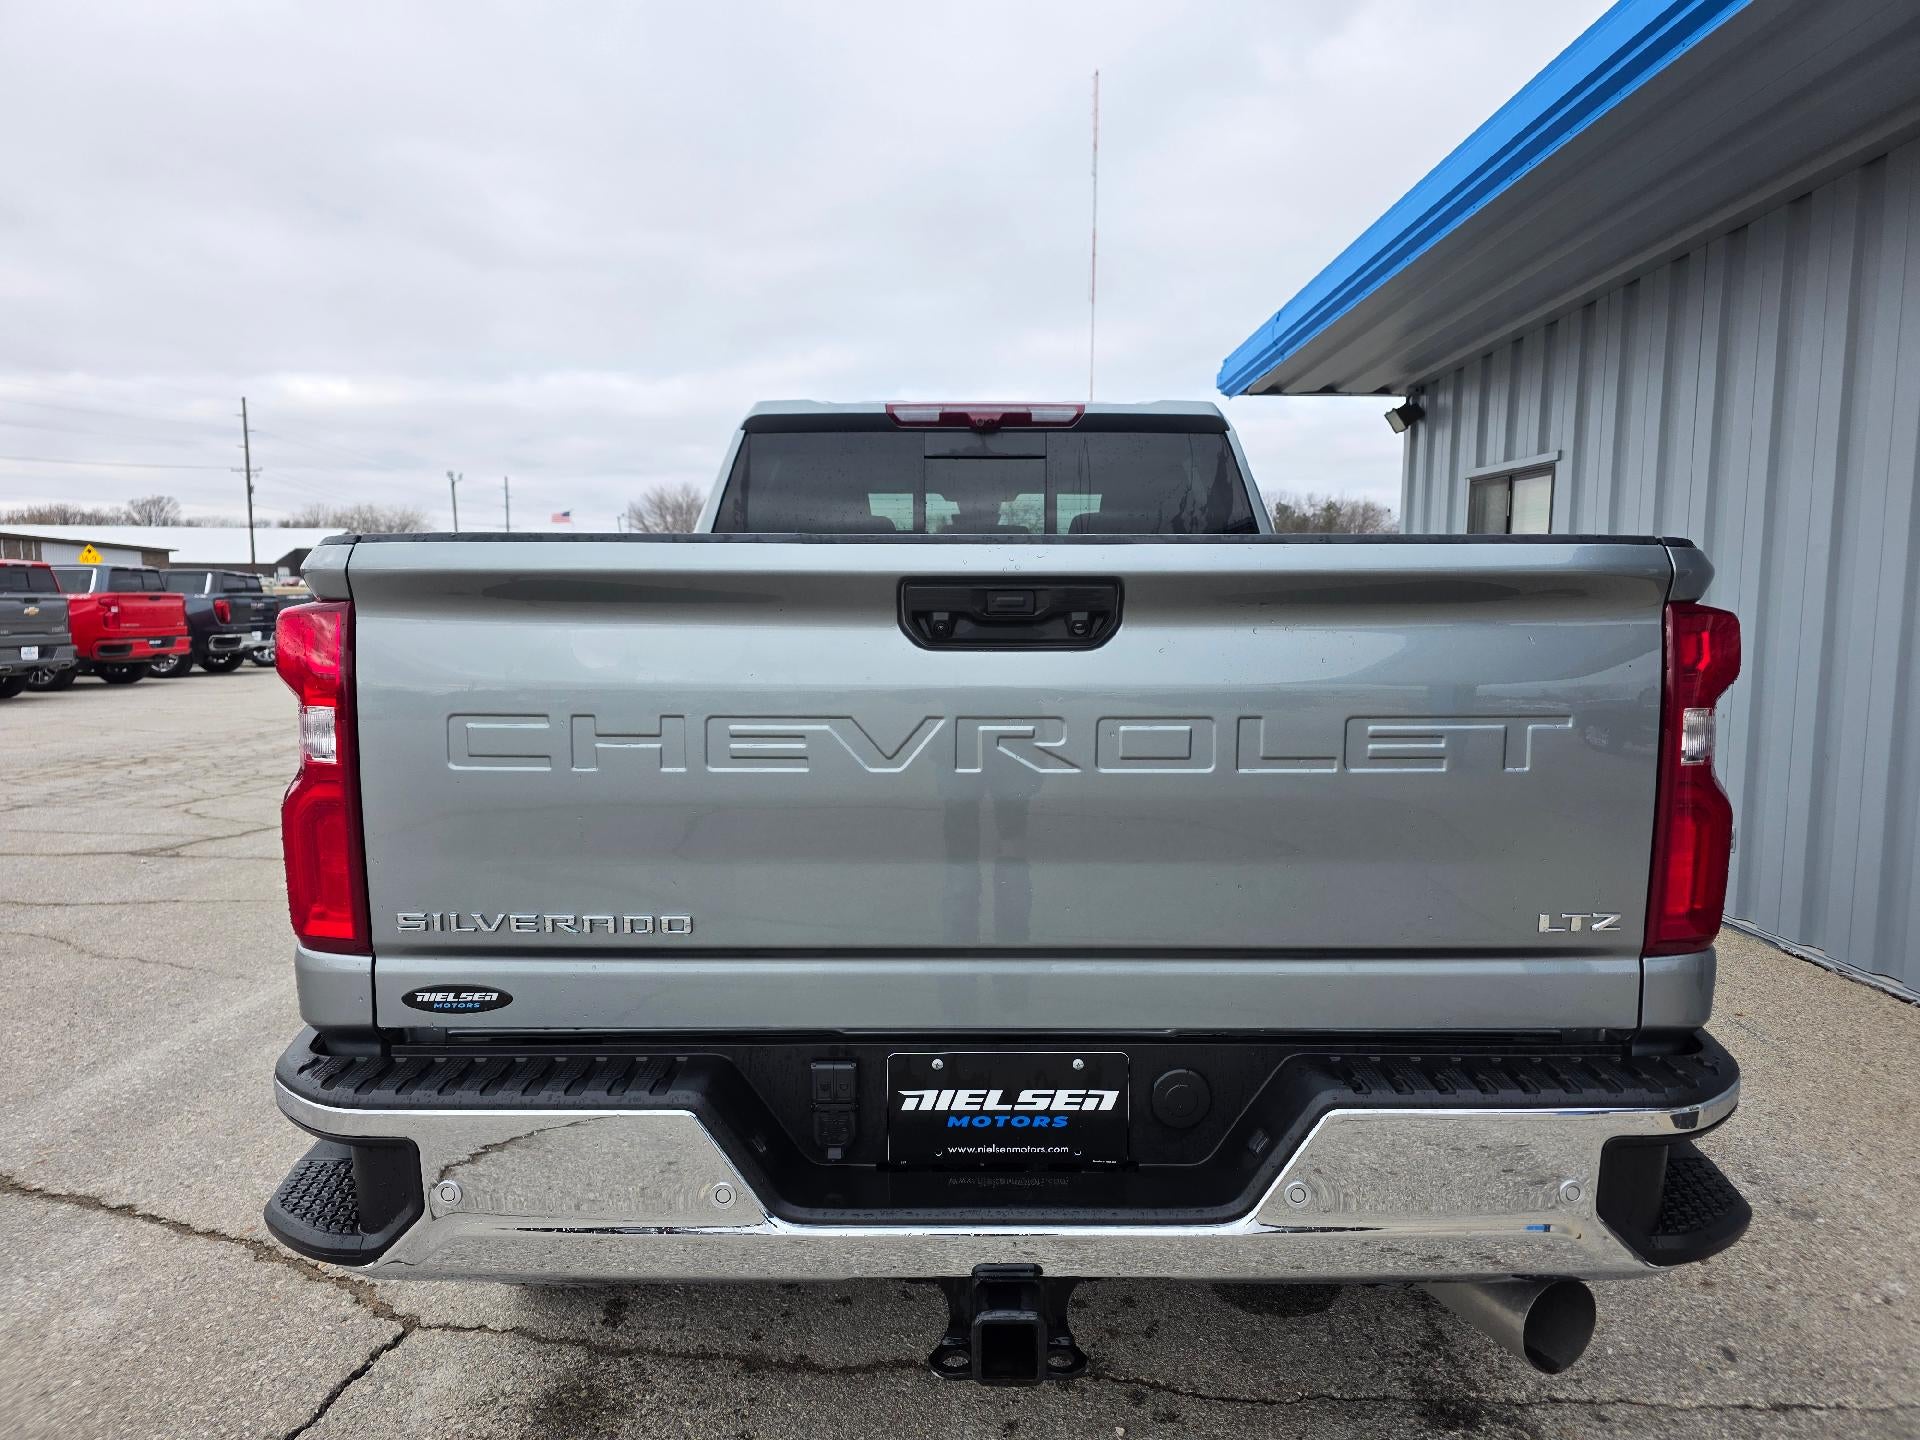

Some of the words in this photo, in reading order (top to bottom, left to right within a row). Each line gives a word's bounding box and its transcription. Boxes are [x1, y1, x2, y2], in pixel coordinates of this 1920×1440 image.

[447, 713, 1573, 774] CHEVROLET
[396, 912, 694, 934] SILVERADO
[1538, 912, 1622, 933] LTZ
[415, 992, 499, 1002] NIELSEN
[898, 1089, 1119, 1111] NIELSEN
[947, 1115, 1069, 1128] MOTORS
[947, 1143, 1069, 1154] www.nielsenmotors.com
